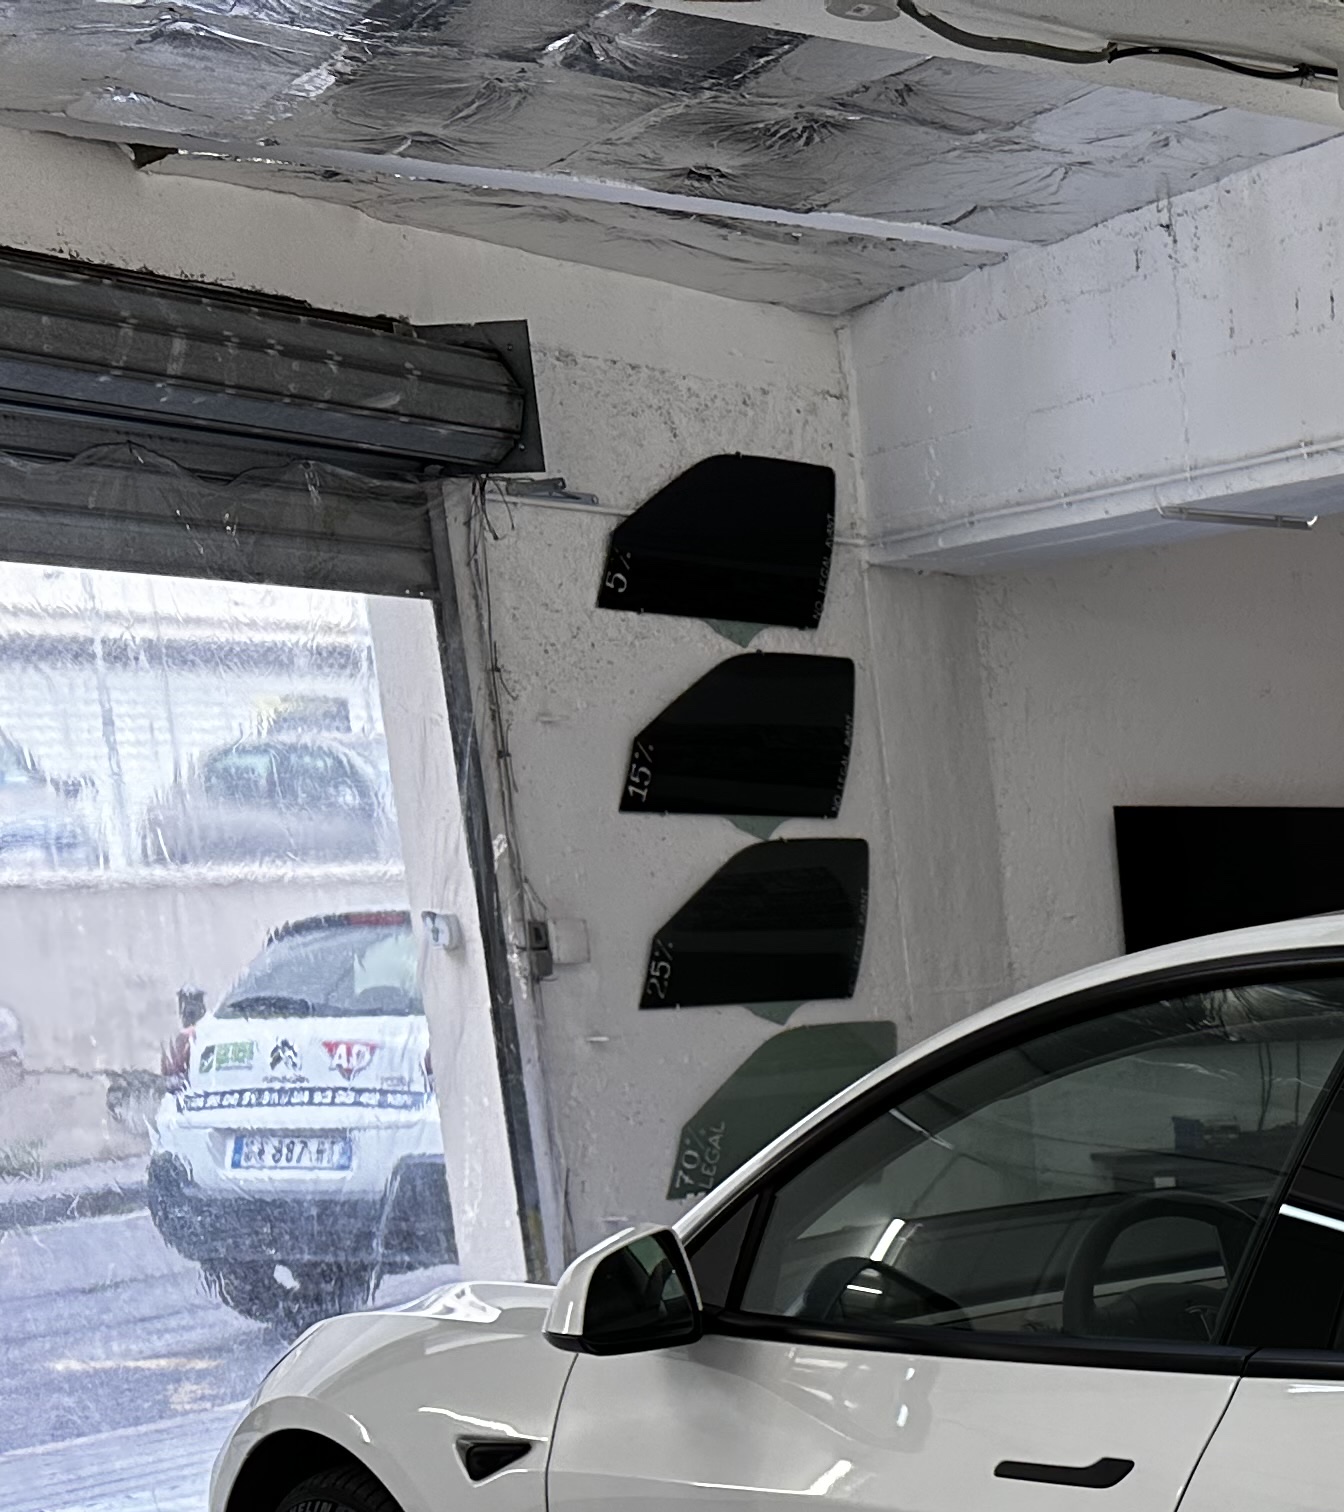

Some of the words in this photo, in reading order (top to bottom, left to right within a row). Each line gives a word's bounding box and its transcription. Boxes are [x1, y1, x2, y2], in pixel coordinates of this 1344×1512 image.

[605, 547, 632, 593] 5%
[627, 741, 655, 803] 15%
[646, 939, 674, 1000] 25%
[675, 1124, 707, 1189] 70%
[698, 1121, 726, 1189] LEGAL
